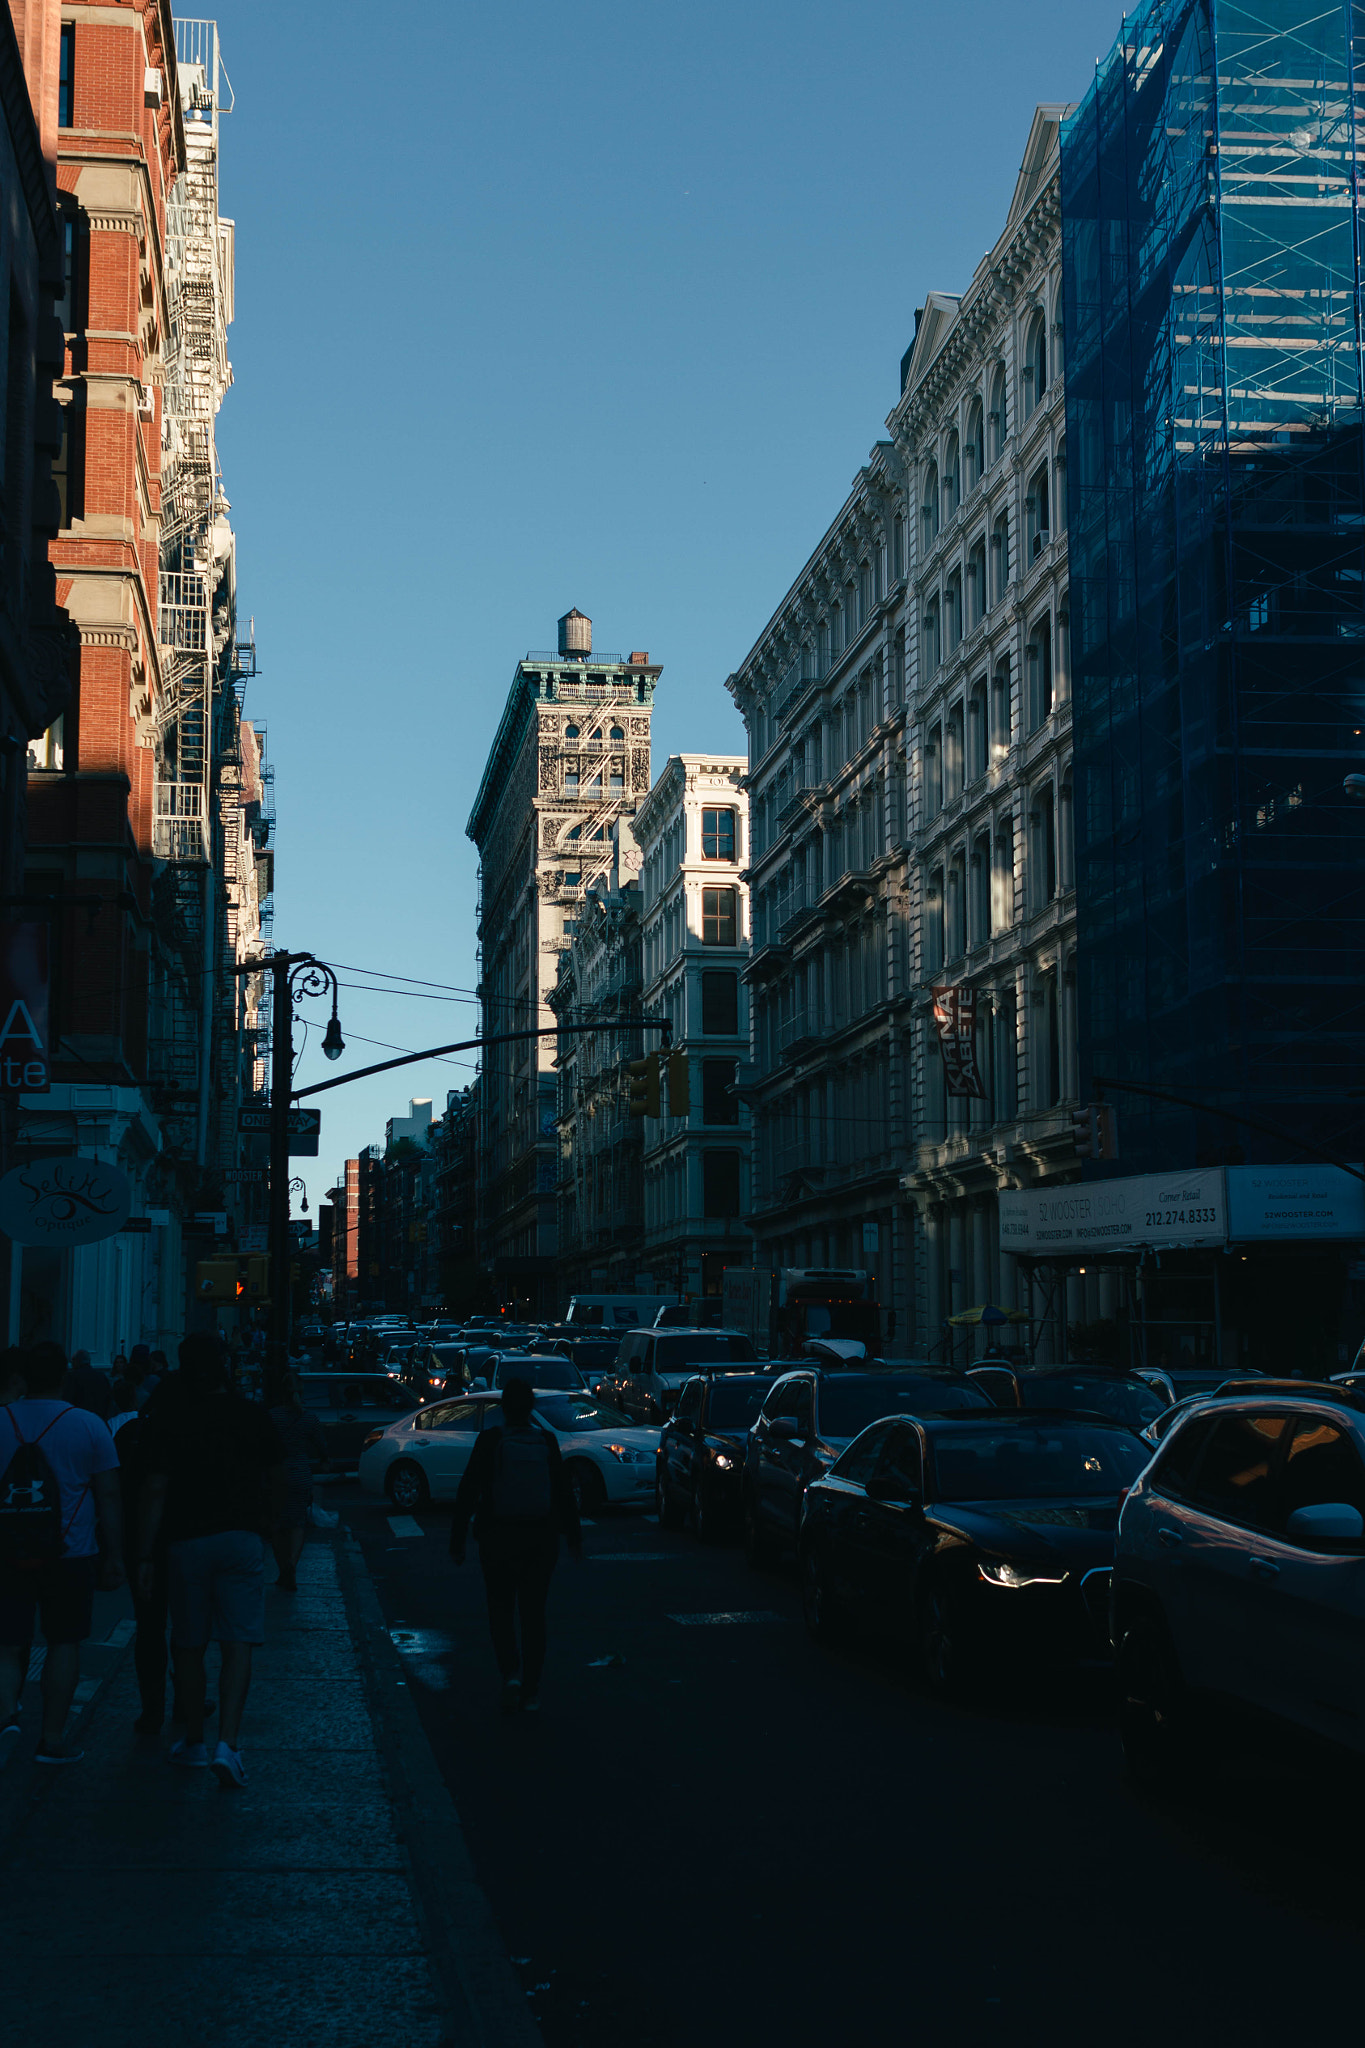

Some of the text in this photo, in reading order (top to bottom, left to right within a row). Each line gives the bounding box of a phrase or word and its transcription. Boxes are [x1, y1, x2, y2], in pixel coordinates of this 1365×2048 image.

[936, 989, 968, 1094] KIRNA
[957, 989, 981, 1096] ZABETE
[244, 1115, 272, 1126] ONE
[225, 1170, 263, 1182] WOOSTER
[1181, 1188, 1201, 1202] Retail
[1039, 1203, 1048, 1222] 52
[1050, 1198, 1092, 1221] WOOSTER
[1145, 1207, 1216, 1227] 212.274.8333
[1264, 1210, 1334, 1219] 52WOOSTER.COM
[1036, 1228, 1073, 1241] 52WOOSTER.COM
